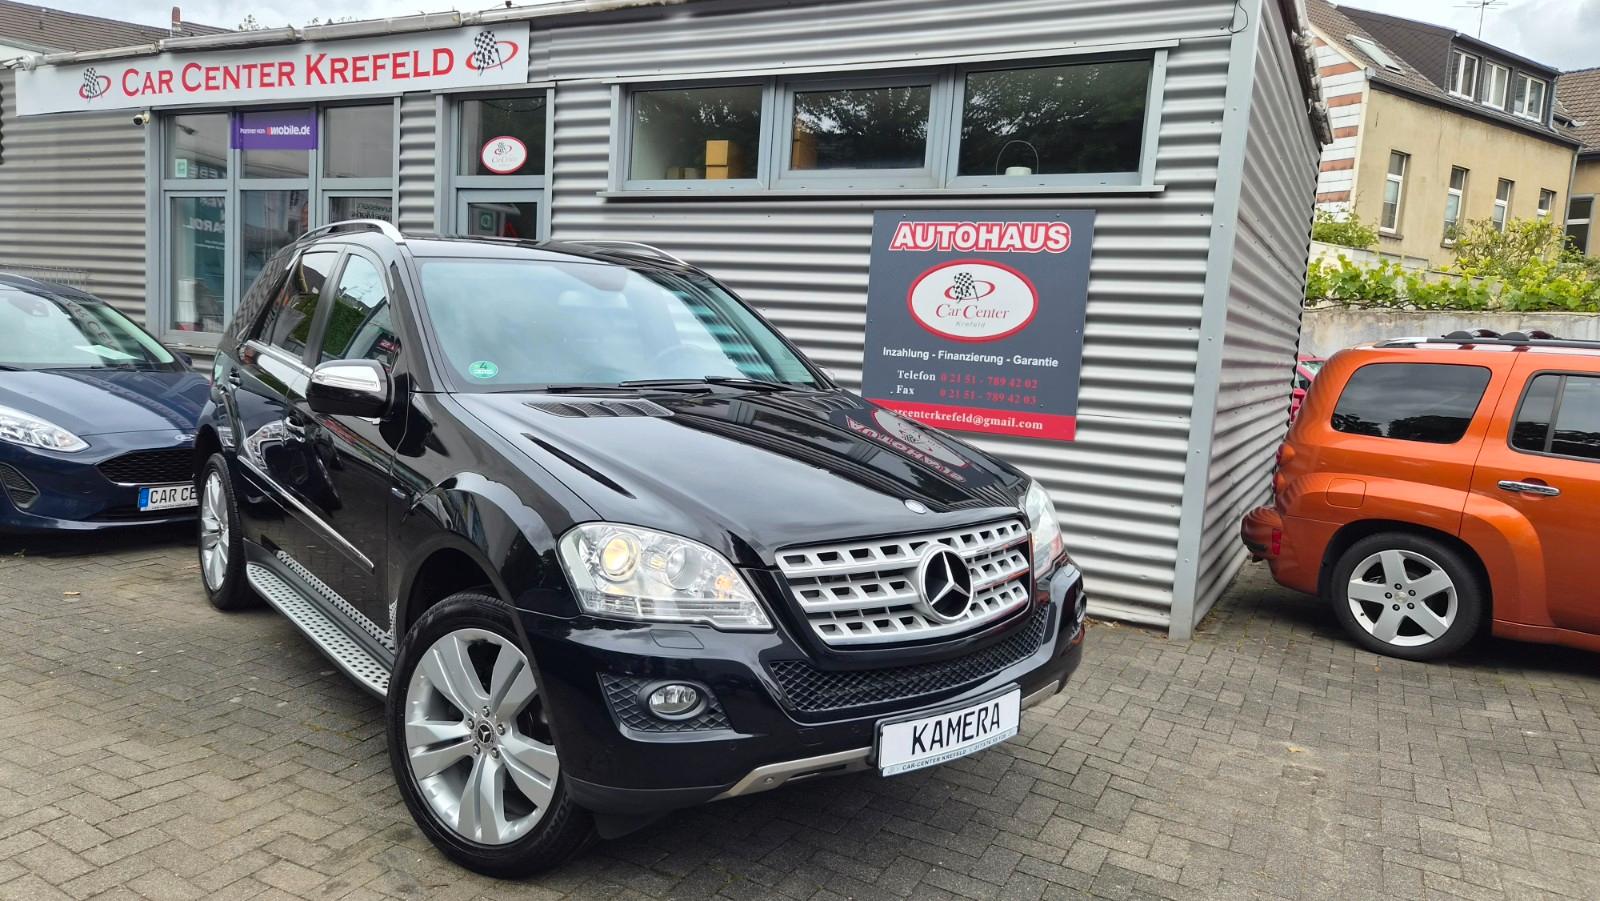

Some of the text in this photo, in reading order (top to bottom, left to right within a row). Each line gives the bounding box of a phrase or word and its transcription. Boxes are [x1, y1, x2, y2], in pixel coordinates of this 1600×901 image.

[122, 47, 455, 97] CAR CENTER KREFELD
[889, 221, 1072, 253] AUTOHAUS
[936, 303, 1010, 319] Car Center
[882, 346, 929, 360] Inzahlung
[938, 350, 1004, 365] Finanzierung
[1012, 355, 1059, 367] Garantie
[897, 370, 936, 381] Telefon
[896, 384, 914, 395] Fax
[150, 488, 177, 504] CAR
[911, 702, 1000, 755] KAMERA
